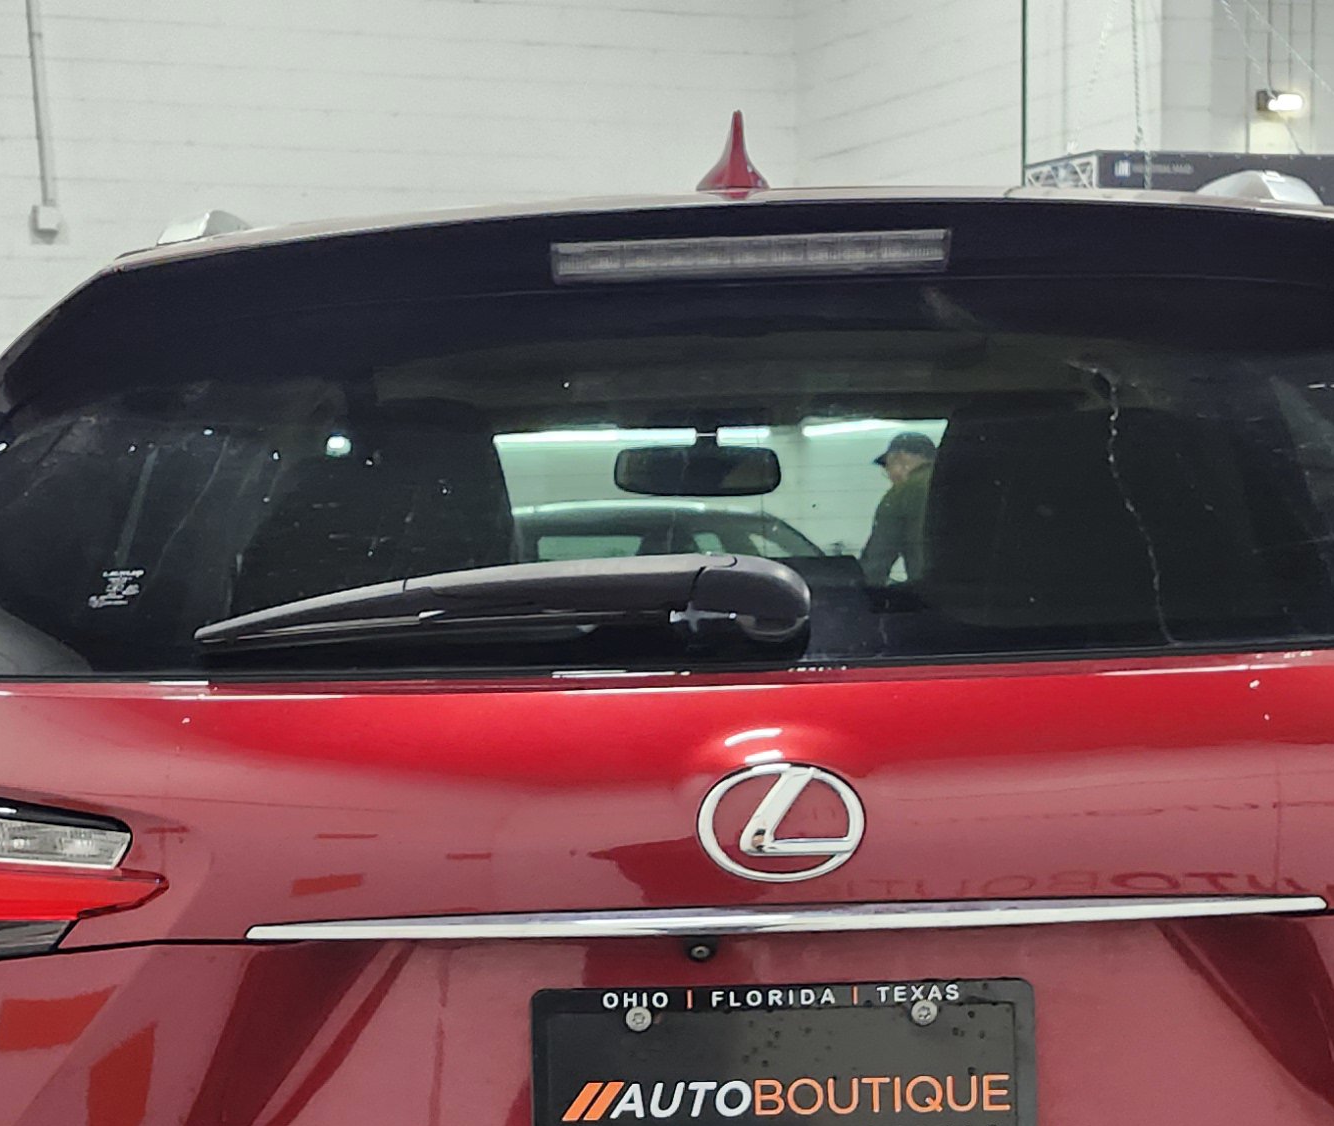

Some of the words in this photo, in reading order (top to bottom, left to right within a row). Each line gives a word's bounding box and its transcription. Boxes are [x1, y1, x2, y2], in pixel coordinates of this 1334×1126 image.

[602, 991, 670, 1010] OHIO
[710, 987, 836, 1008] FLORIDA
[876, 983, 960, 1003] TEXAS
